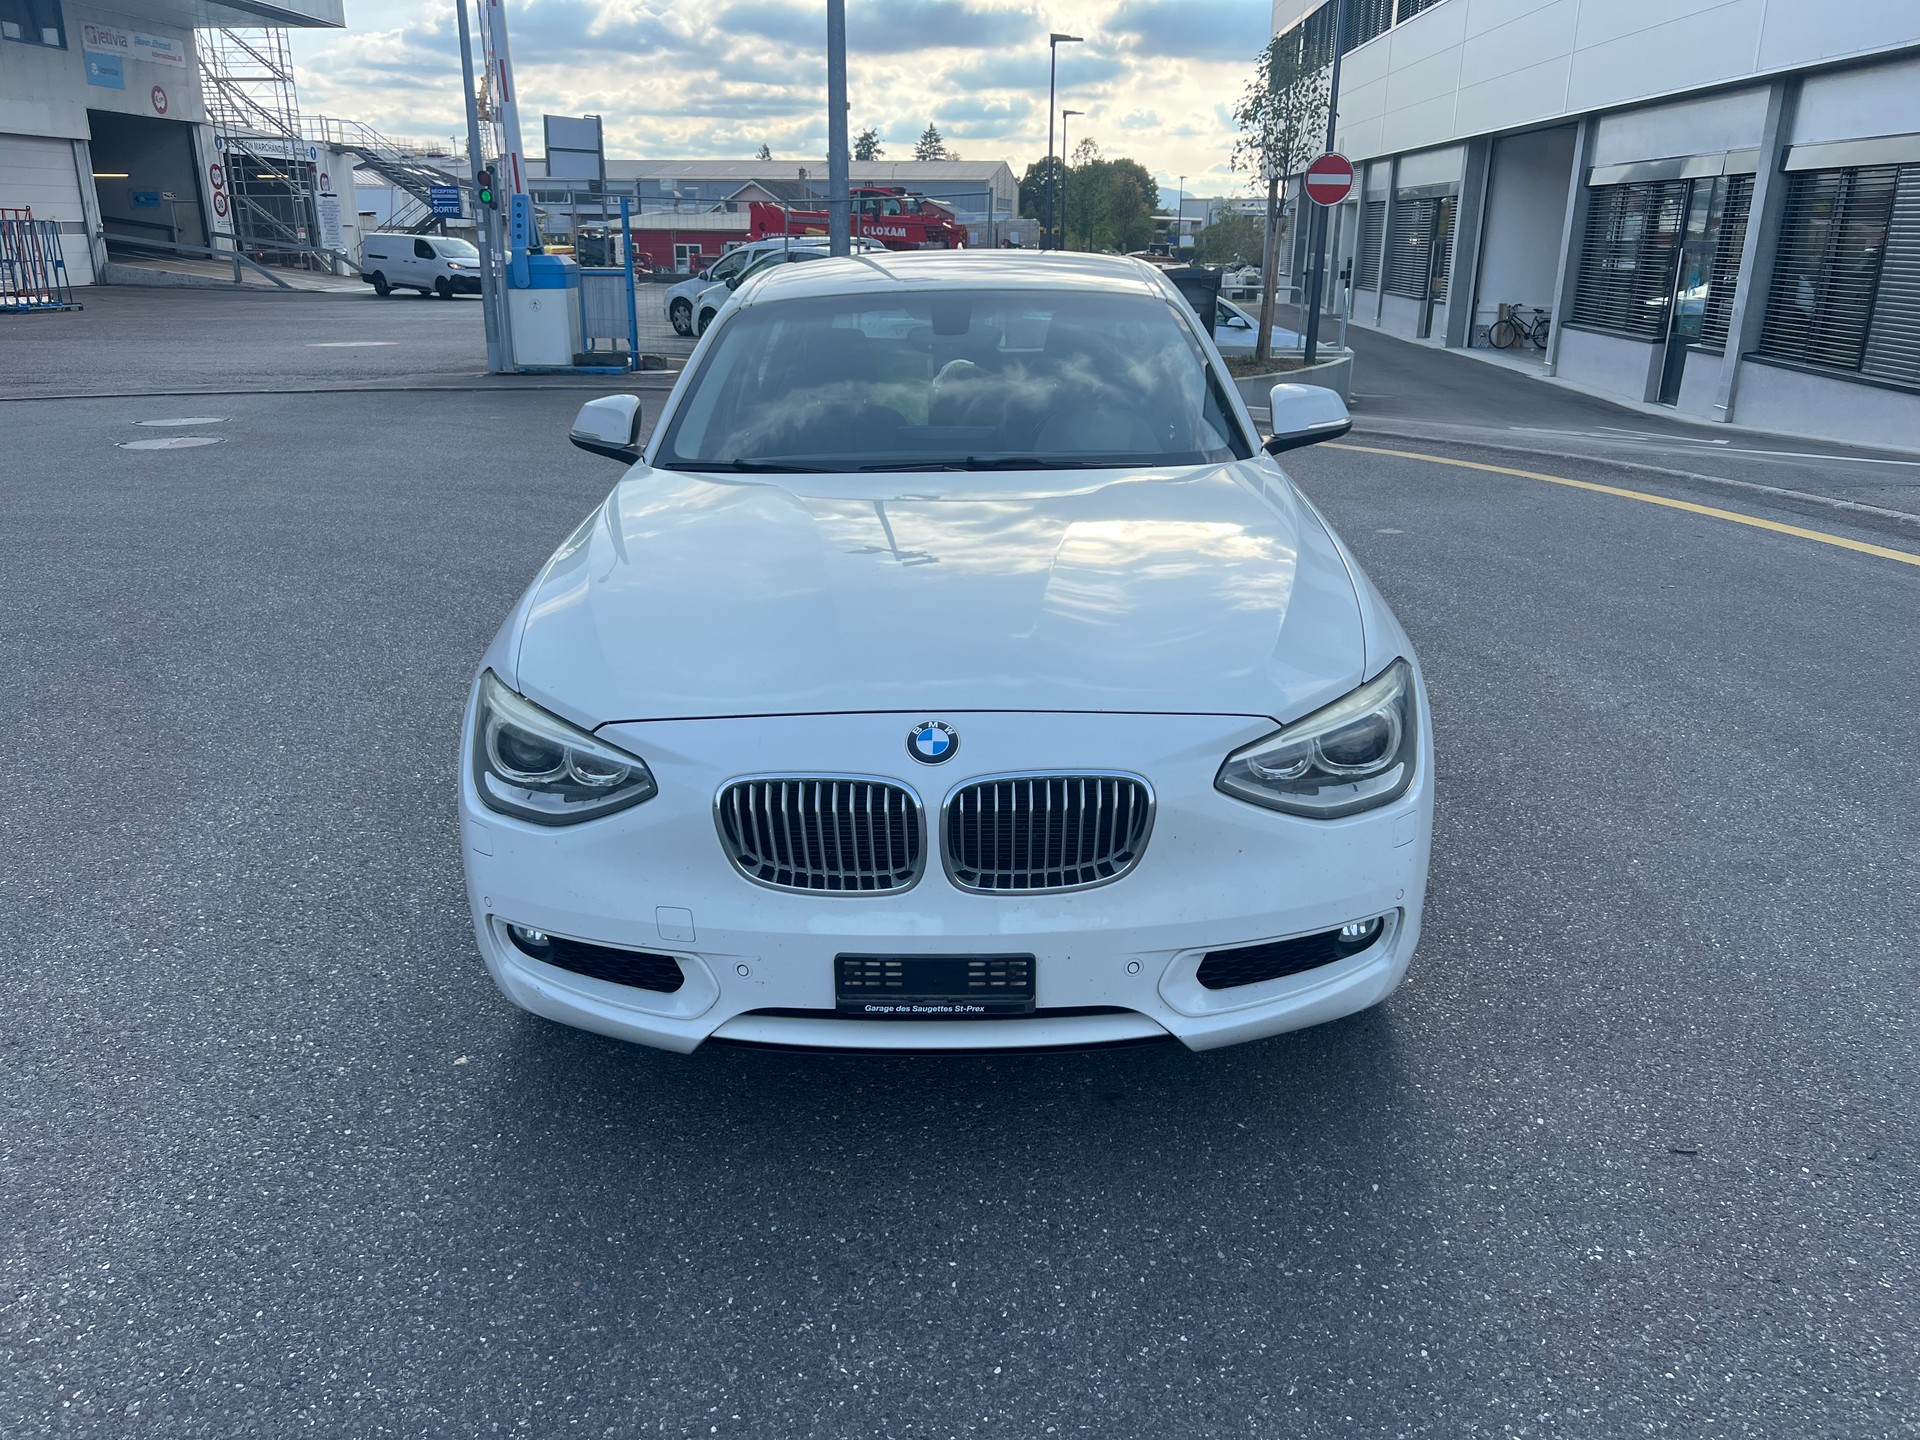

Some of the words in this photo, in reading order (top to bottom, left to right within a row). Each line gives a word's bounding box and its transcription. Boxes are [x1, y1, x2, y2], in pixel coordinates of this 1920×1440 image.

[871, 226, 906, 237] LOXAM
[912, 721, 955, 735] BMW
[865, 1004, 894, 1013] Garage
[896, 1004, 911, 1012] des
[912, 1004, 953, 1013] Saugettes
[954, 1004, 985, 1012] St-Prex
